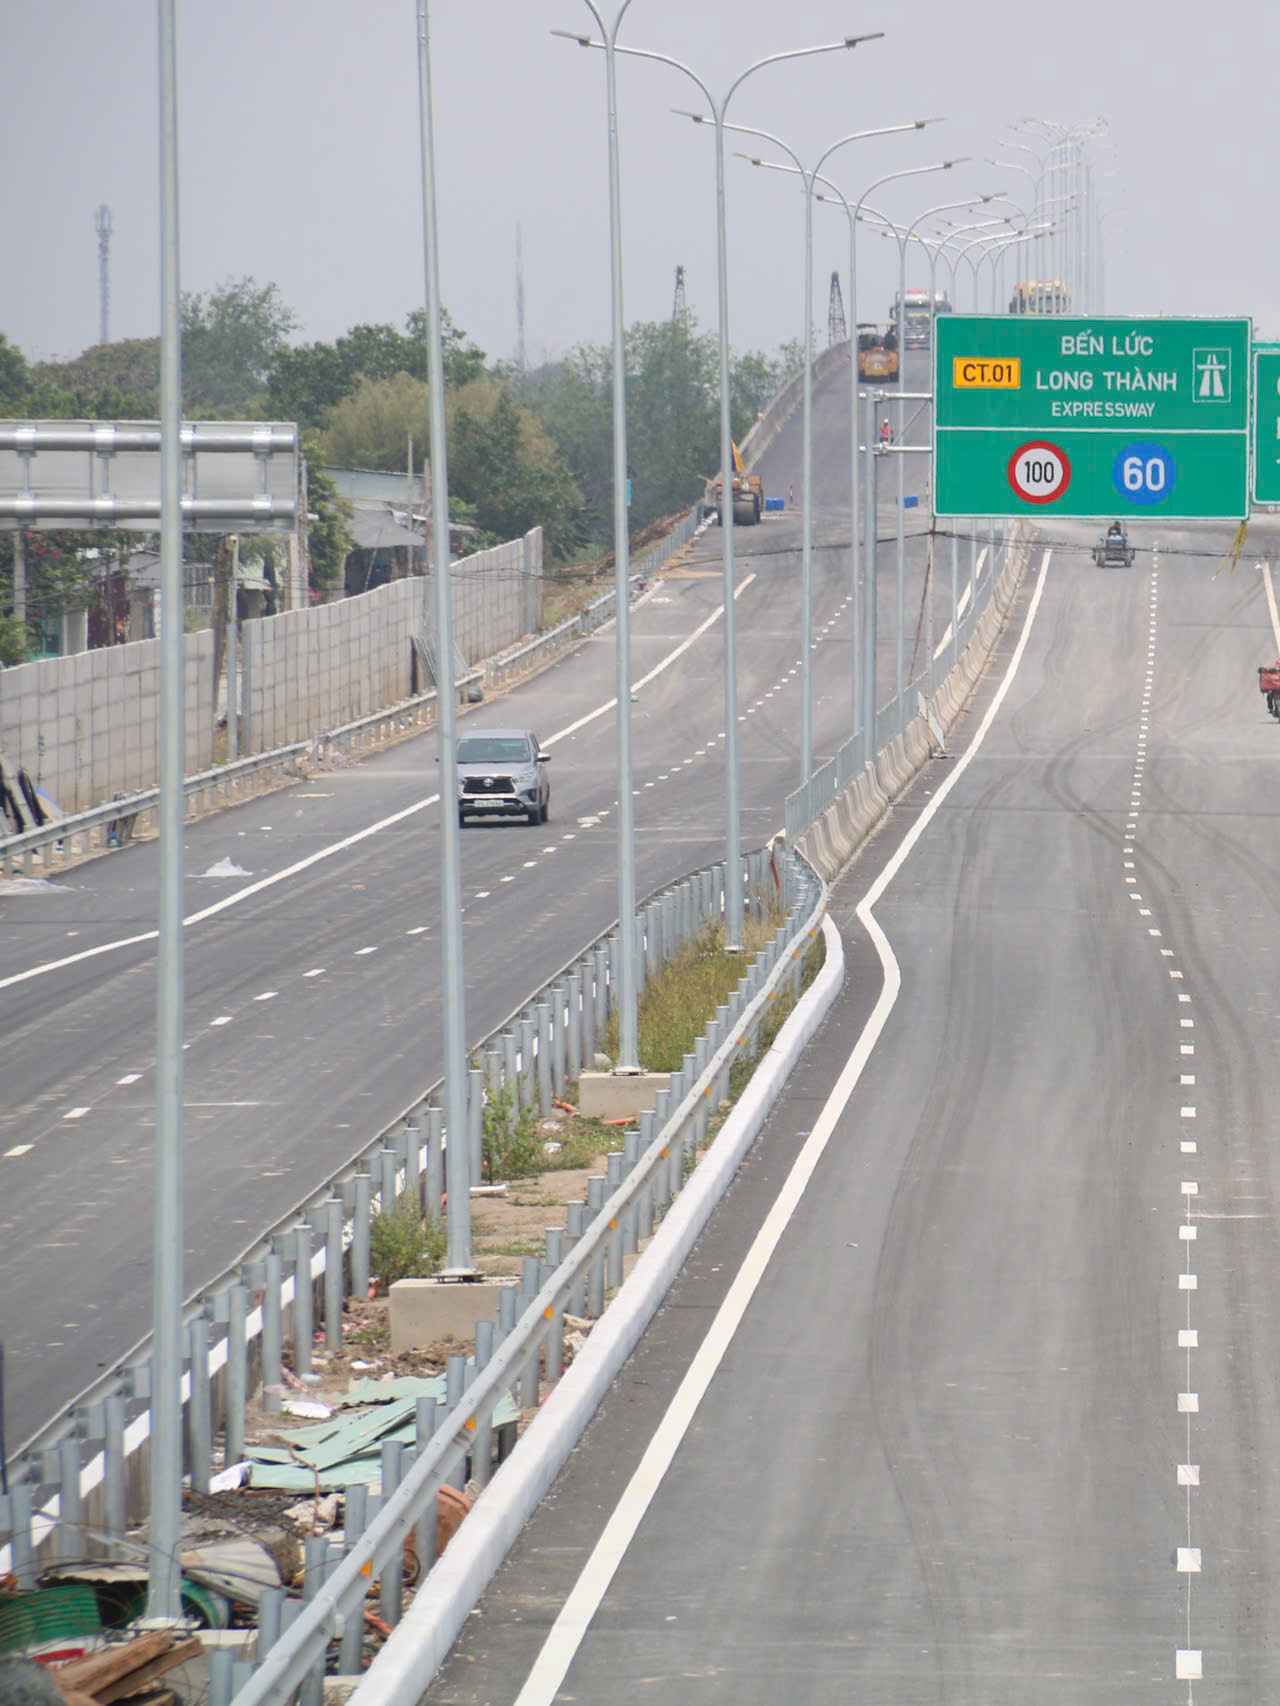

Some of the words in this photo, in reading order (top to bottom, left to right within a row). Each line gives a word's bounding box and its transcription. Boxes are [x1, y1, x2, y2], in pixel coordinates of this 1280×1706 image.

[1061, 329, 1104, 356] BẾN
[1112, 330, 1153, 356] LỨC
[963, 363, 1012, 383] CT.01
[1036, 370, 1093, 391] LONG
[1104, 367, 1177, 392] THÀNH
[1052, 402, 1155, 418] EXPRESSWAY
[1025, 460, 1055, 484] 100
[1123, 456, 1165, 492] 60
